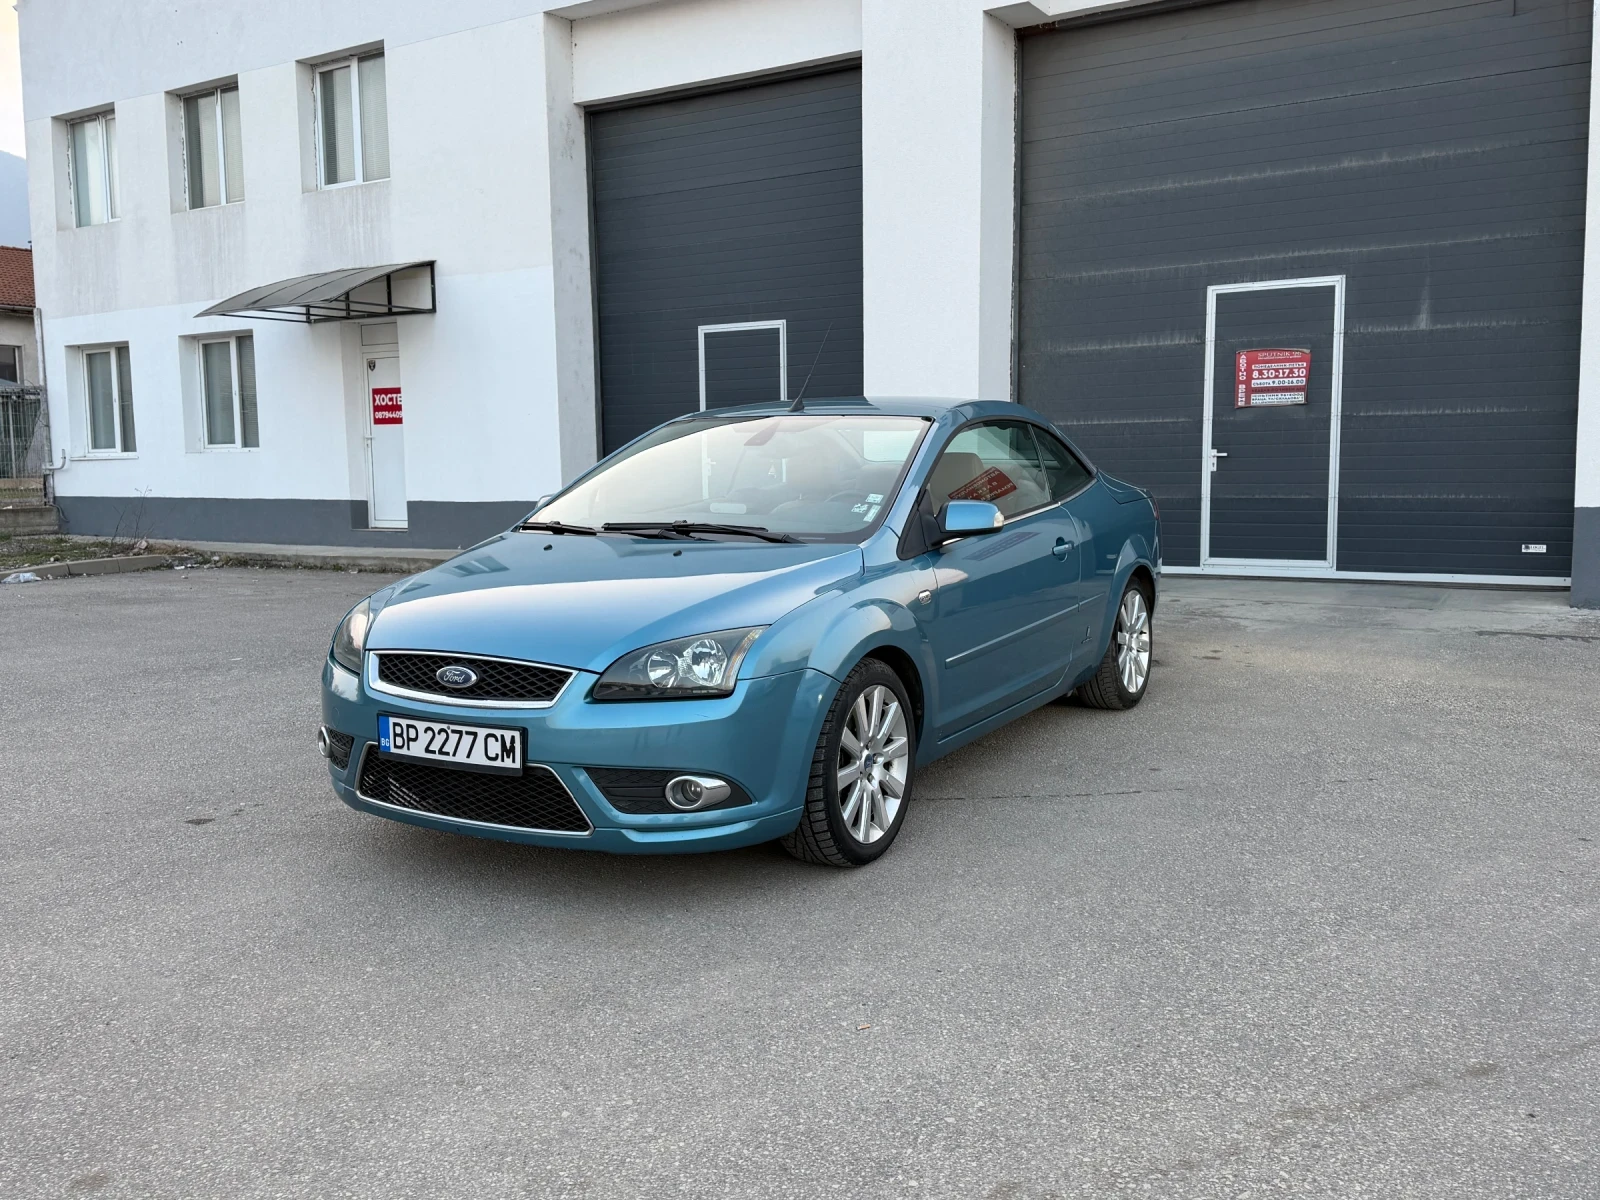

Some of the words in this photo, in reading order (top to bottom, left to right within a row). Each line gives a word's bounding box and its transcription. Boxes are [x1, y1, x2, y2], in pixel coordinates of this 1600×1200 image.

[1252, 368, 1306, 378] 8.30-17.30
[444, 670, 464, 683] Ford
[381, 738, 390, 747] BG
[392, 722, 418, 751] BP
[424, 726, 478, 758] 2277
[484, 733, 516, 764] CM
